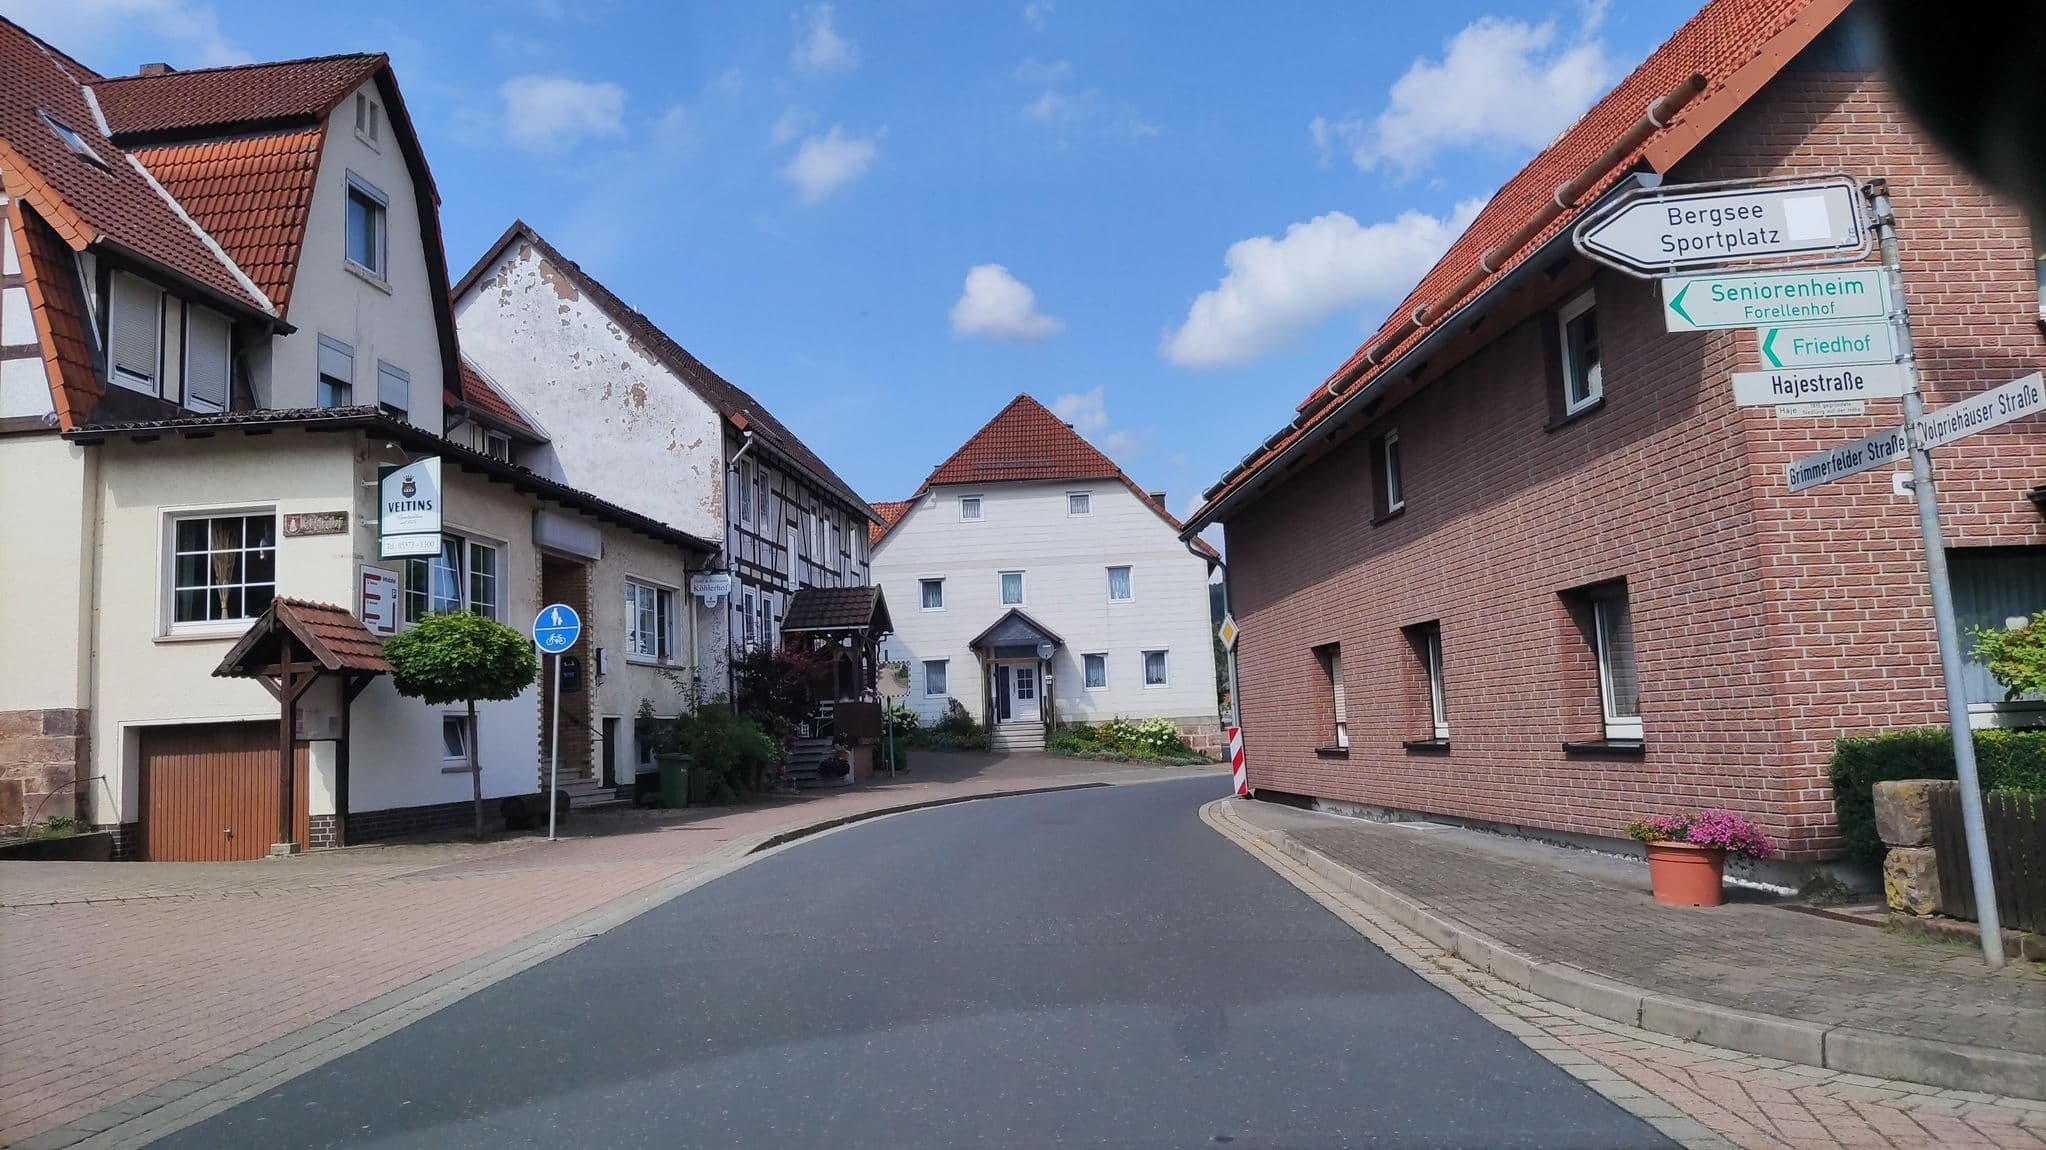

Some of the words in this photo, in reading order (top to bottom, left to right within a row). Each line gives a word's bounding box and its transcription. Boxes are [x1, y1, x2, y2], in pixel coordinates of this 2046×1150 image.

[1667, 203, 1765, 227] Bergsee
[1660, 227, 1781, 256] Sportplatz
[1711, 277, 1865, 302] Seniorenheim
[1744, 302, 1837, 319] Forellenhof
[1793, 335, 1872, 355] Friedhof
[1772, 371, 1865, 398] Hajestraße
[1917, 401, 1994, 442] Volpriehäuser
[1998, 384, 2040, 415] Straße
[1788, 449, 1864, 486] Grimmerfelder
[1867, 434, 1906, 461] Straße
[388, 499, 433, 513] VELTINS
[694, 583, 728, 592] Köhlerhof
